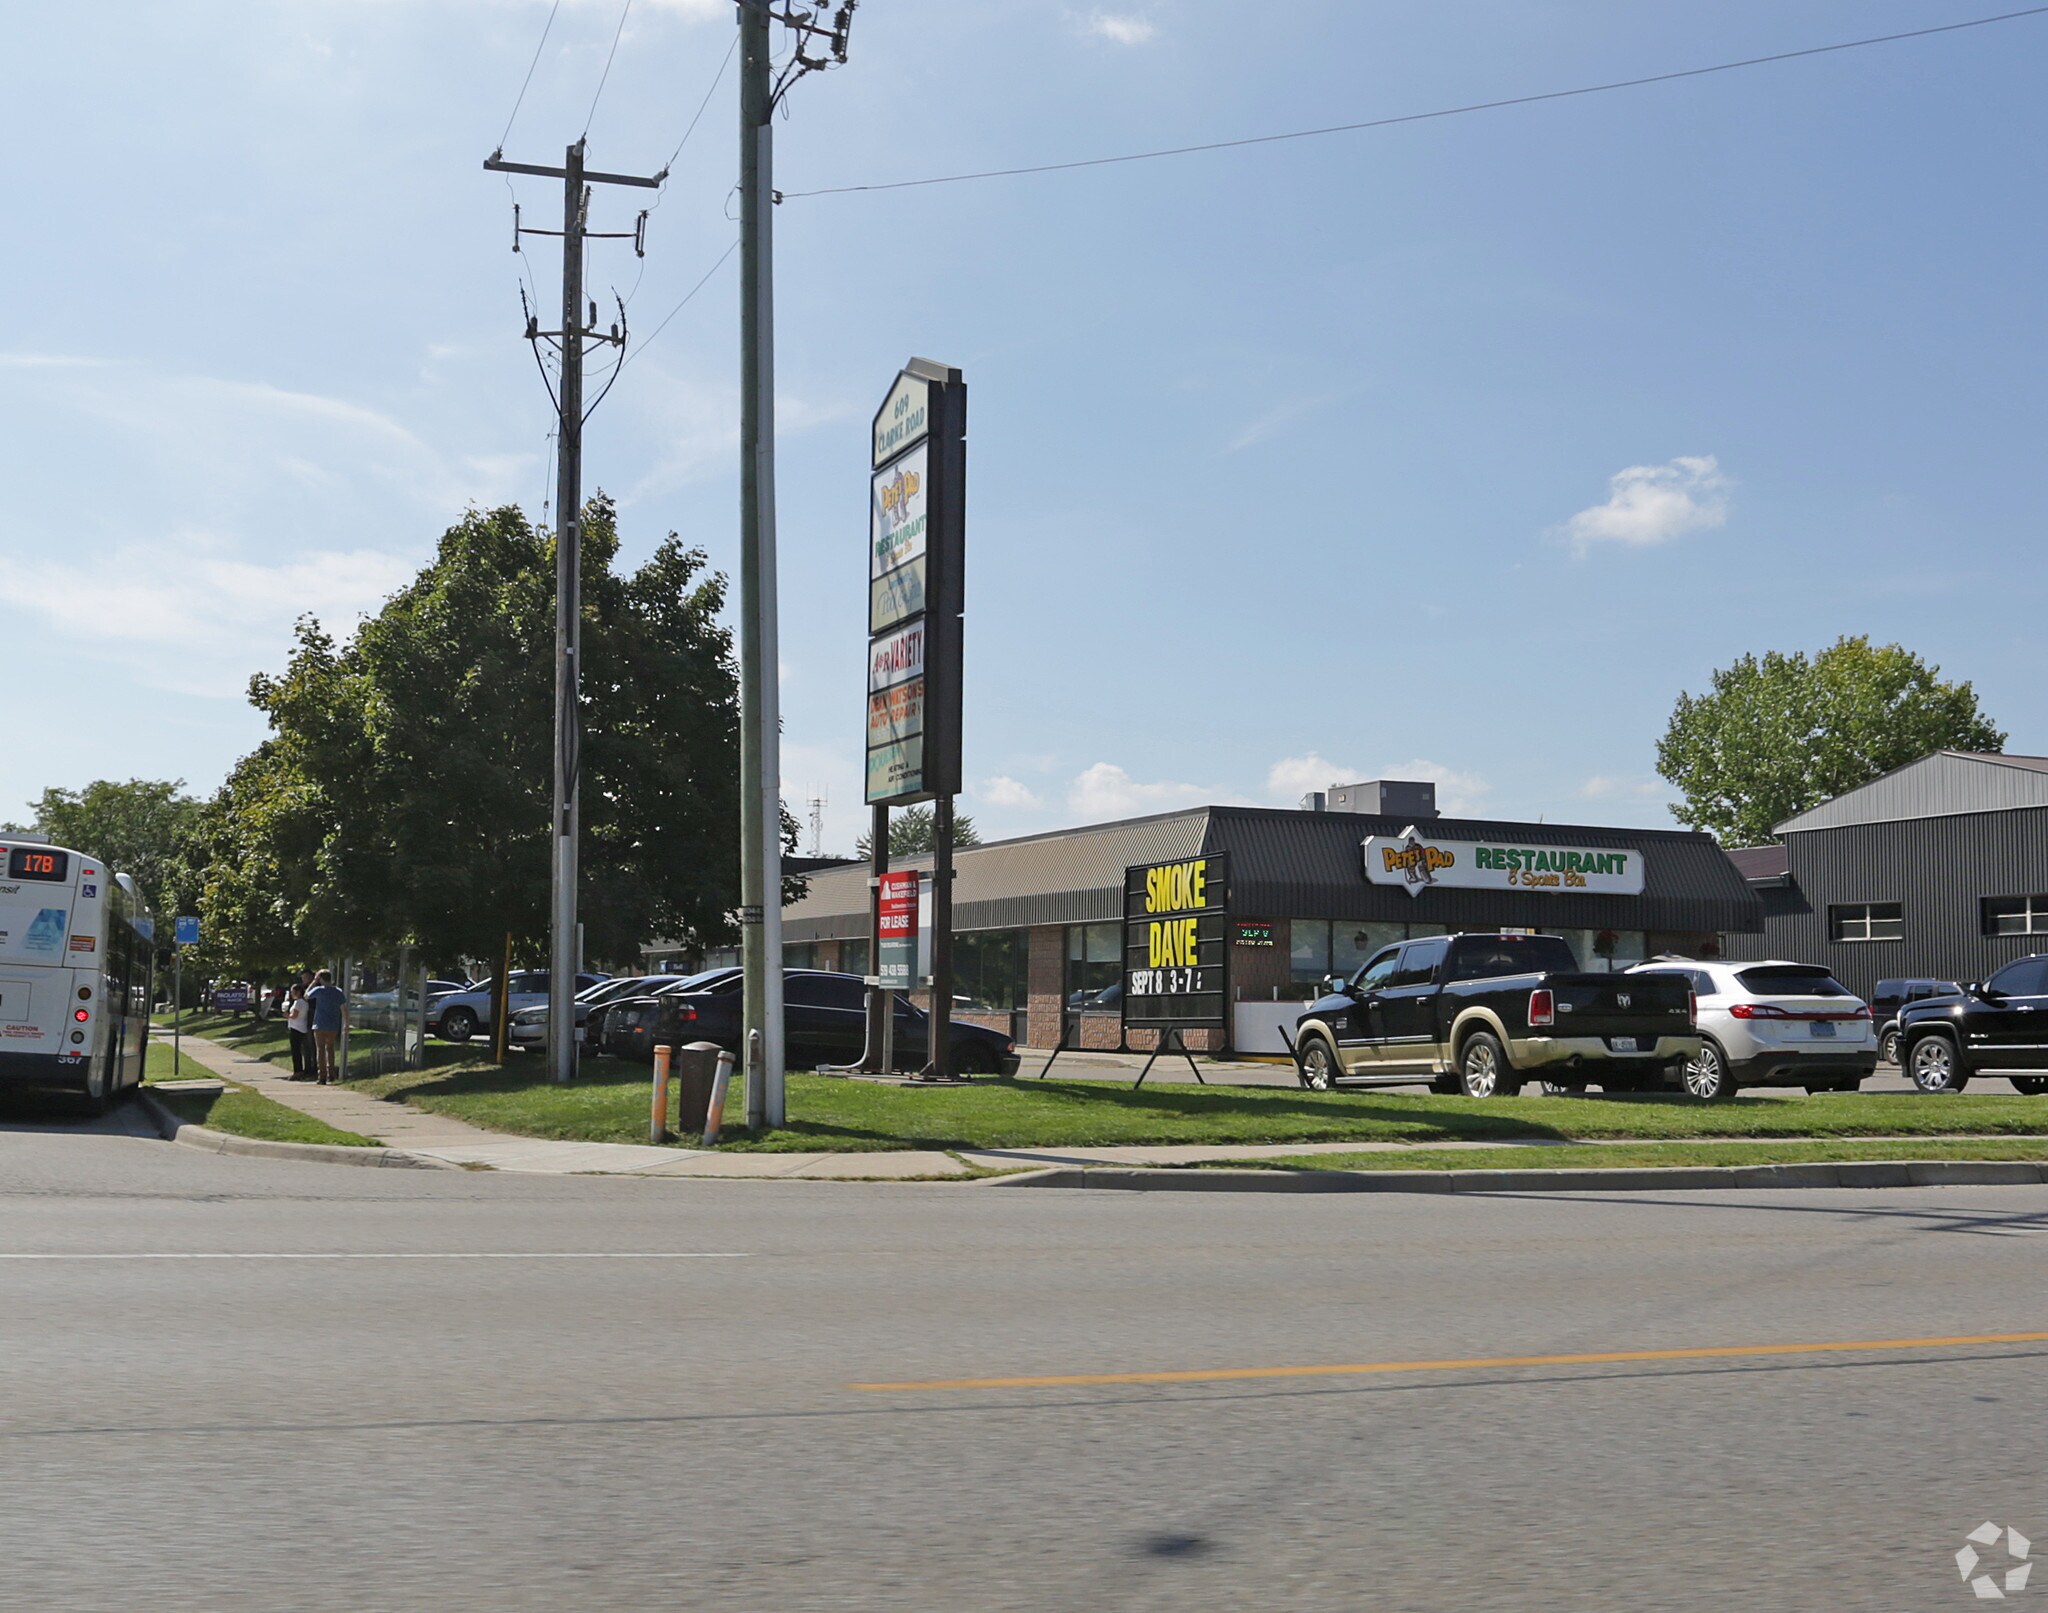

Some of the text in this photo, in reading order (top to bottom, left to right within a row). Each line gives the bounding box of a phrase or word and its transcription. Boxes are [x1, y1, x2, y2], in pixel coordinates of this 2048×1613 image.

[894, 393, 909, 420] 609
[878, 406, 924, 454] CLARKE ROAD
[875, 513, 927, 558] RESTAURANT
[891, 630, 923, 673] VARIETY
[24, 854, 55, 873] 17B
[1425, 846, 1455, 872] PAD
[1475, 847, 1628, 875] RESTAURANT
[1145, 860, 1206, 913] SMOKE
[880, 914, 909, 929] FOR LEASE
[1149, 918, 1198, 968] DAVE
[1132, 970, 1154, 995] SEPT
[1155, 970, 1162, 994] 8
